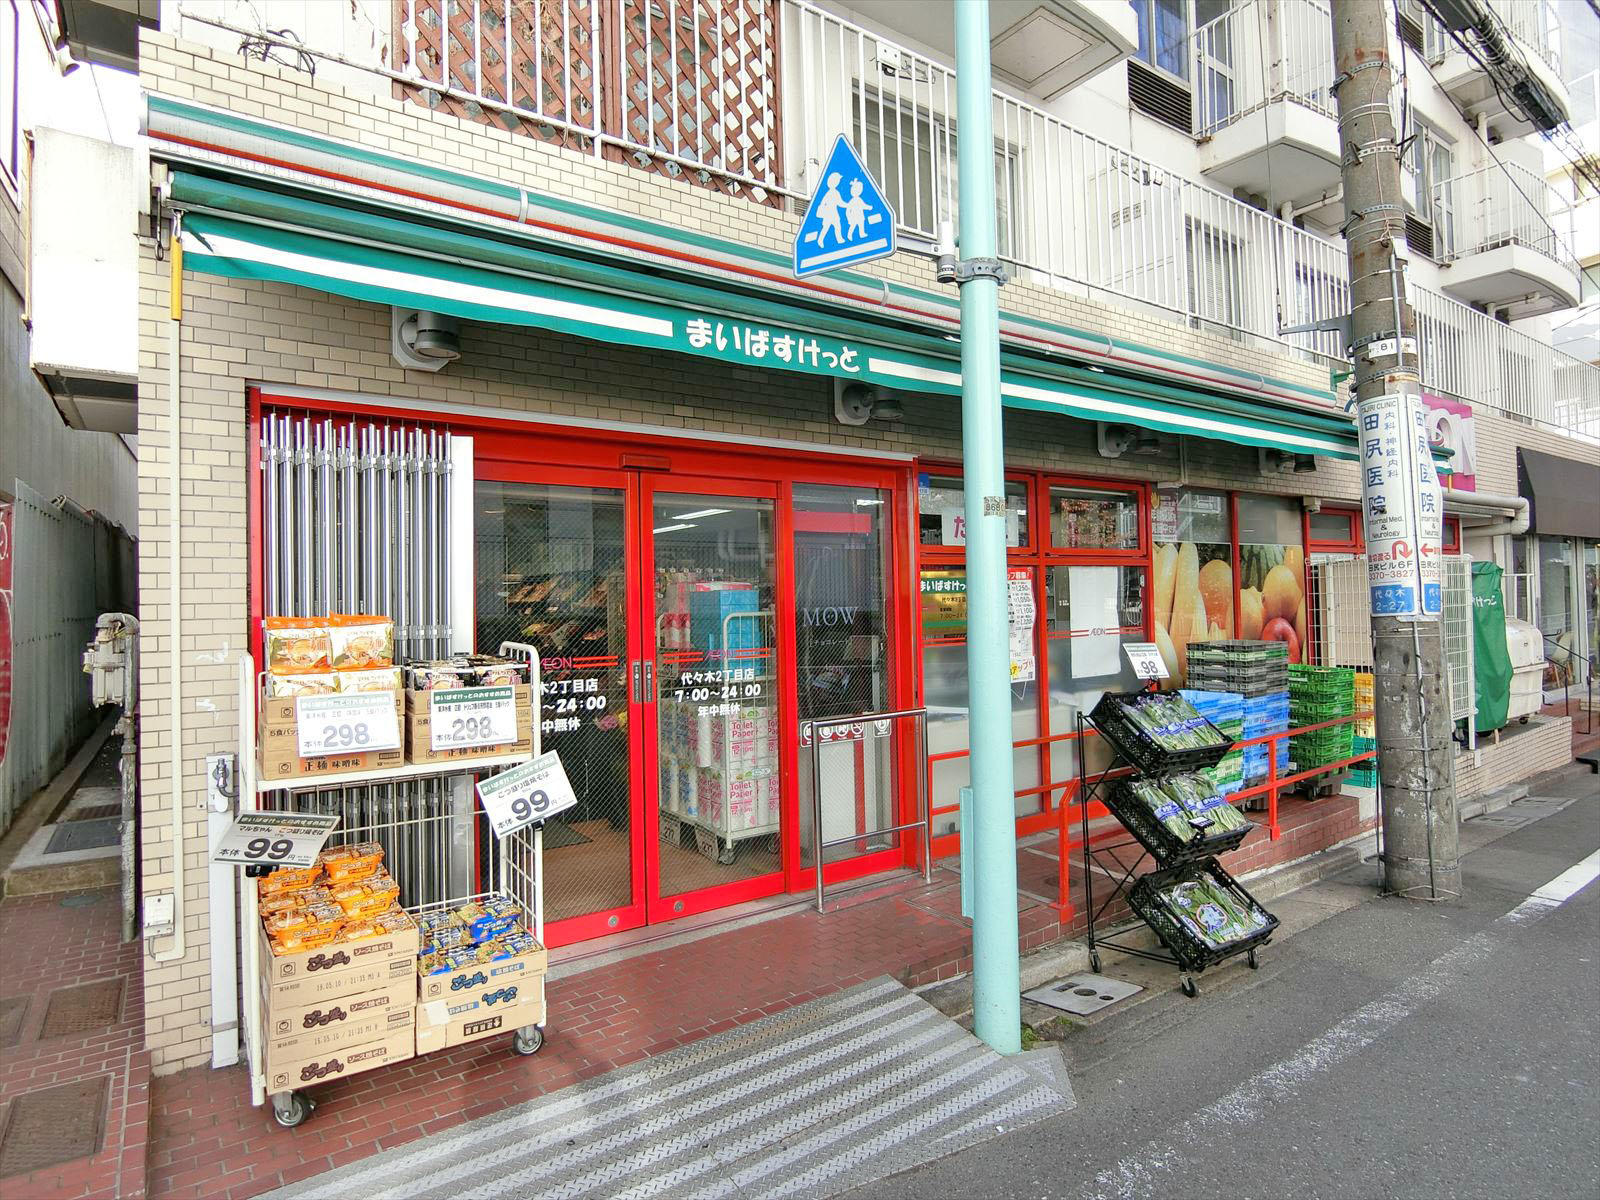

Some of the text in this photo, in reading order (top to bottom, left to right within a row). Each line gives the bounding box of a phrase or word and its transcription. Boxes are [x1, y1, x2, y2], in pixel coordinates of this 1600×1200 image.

[685, 317, 861, 374] まいばすけっと
[1376, 400, 1397, 410] CLINIC
[1363, 412, 1388, 517] 田尻医院
[802, 606, 859, 628] MOW
[680, 668, 755, 686] 代々木2丁目店
[1140, 660, 1159, 675] 98
[697, 702, 741, 718] 年中無休
[322, 722, 371, 748] 298
[452, 716, 493, 741] 298
[511, 789, 550, 821] 99
[239, 825, 272, 833] マルちゃん
[219, 848, 241, 857] 本体
[243, 837, 294, 860] 99
